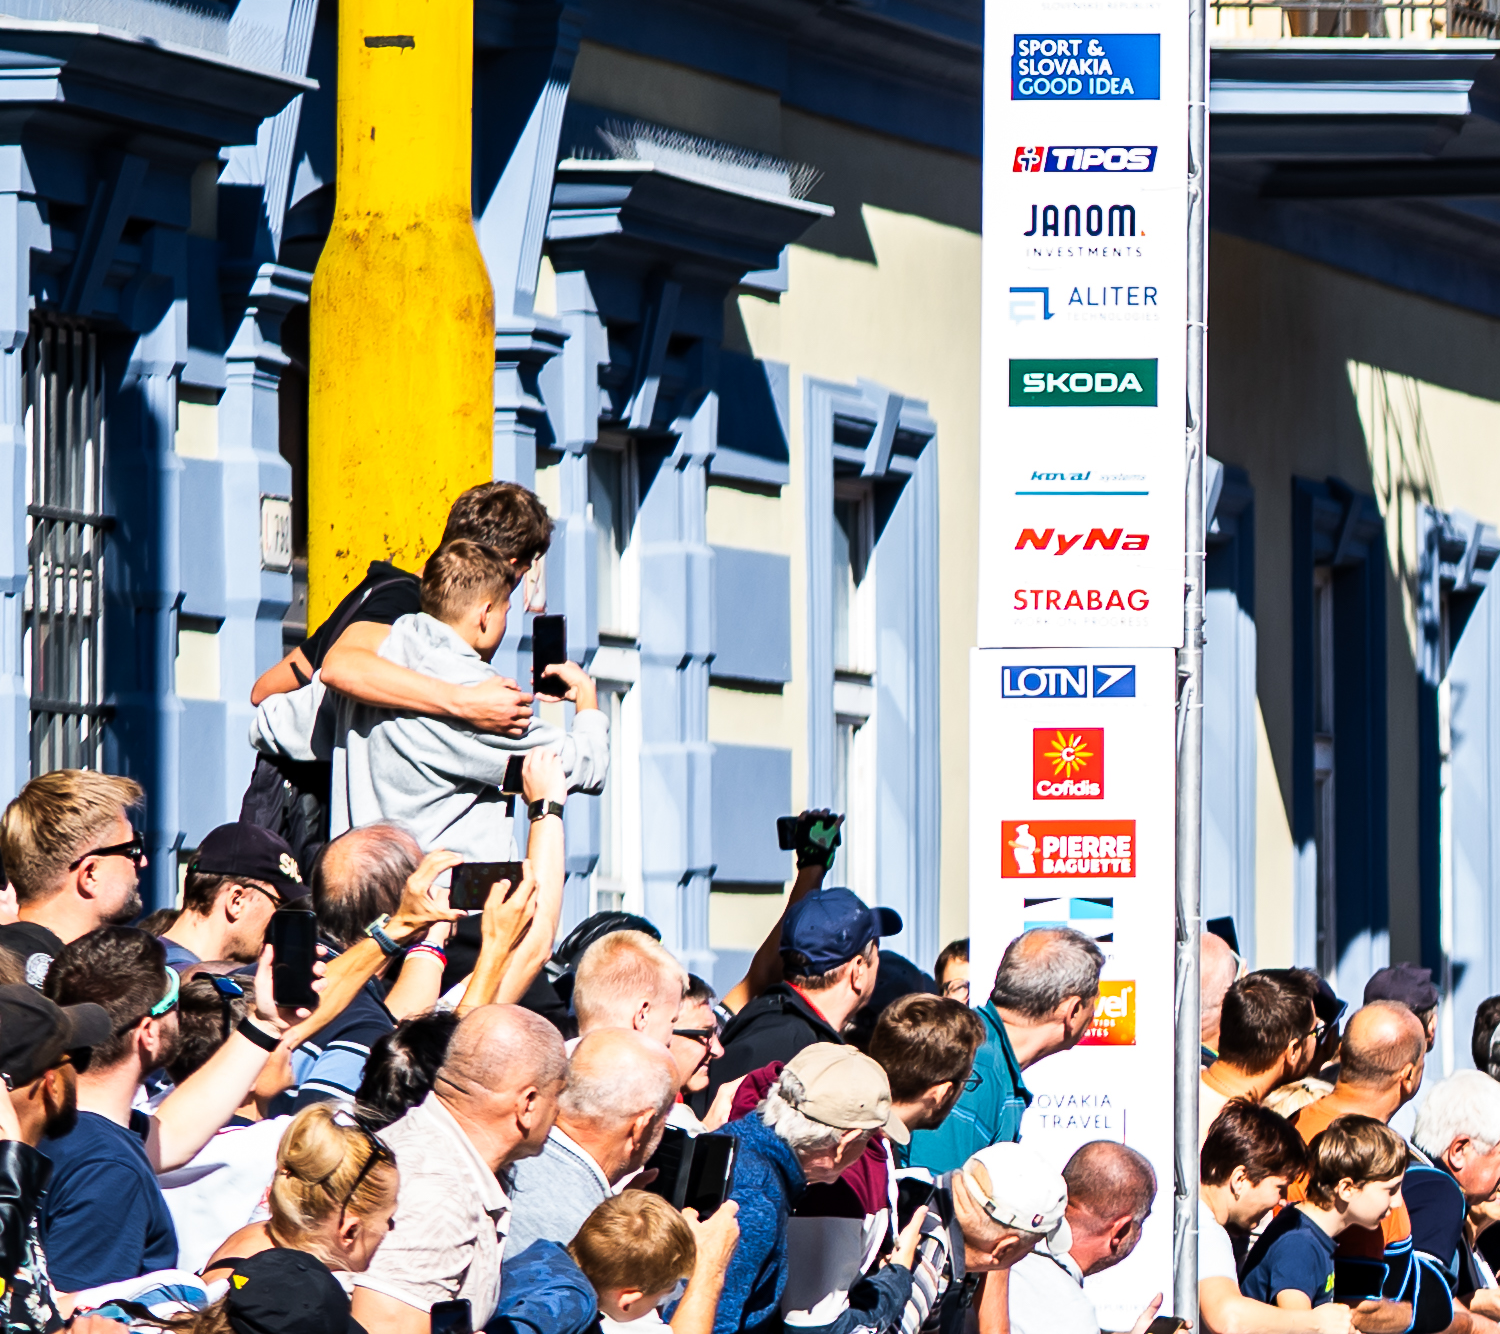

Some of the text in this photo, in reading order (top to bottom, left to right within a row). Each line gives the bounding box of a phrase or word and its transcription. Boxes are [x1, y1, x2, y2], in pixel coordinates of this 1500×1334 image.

[1018, 39, 1106, 57] SPORT &
[1018, 58, 1113, 76] SLOVAKIA
[1019, 77, 1135, 95] GOOD IDEA
[1051, 147, 1152, 171] TIPOS
[1026, 246, 1143, 258] INVESTMENTS
[1067, 286, 1158, 306] ALITER
[1013, 588, 1150, 612] STRABAG
[1004, 667, 1085, 696] LOTN
[1036, 779, 1101, 796] Cofidis
[1042, 835, 1132, 858] PIERRE
[1042, 858, 1132, 874] BAGUETTE
[1094, 988, 1127, 1017] vel
[1029, 1094, 1113, 1109] LOVAKIA
[1039, 1114, 1113, 1129] TRAVEL
